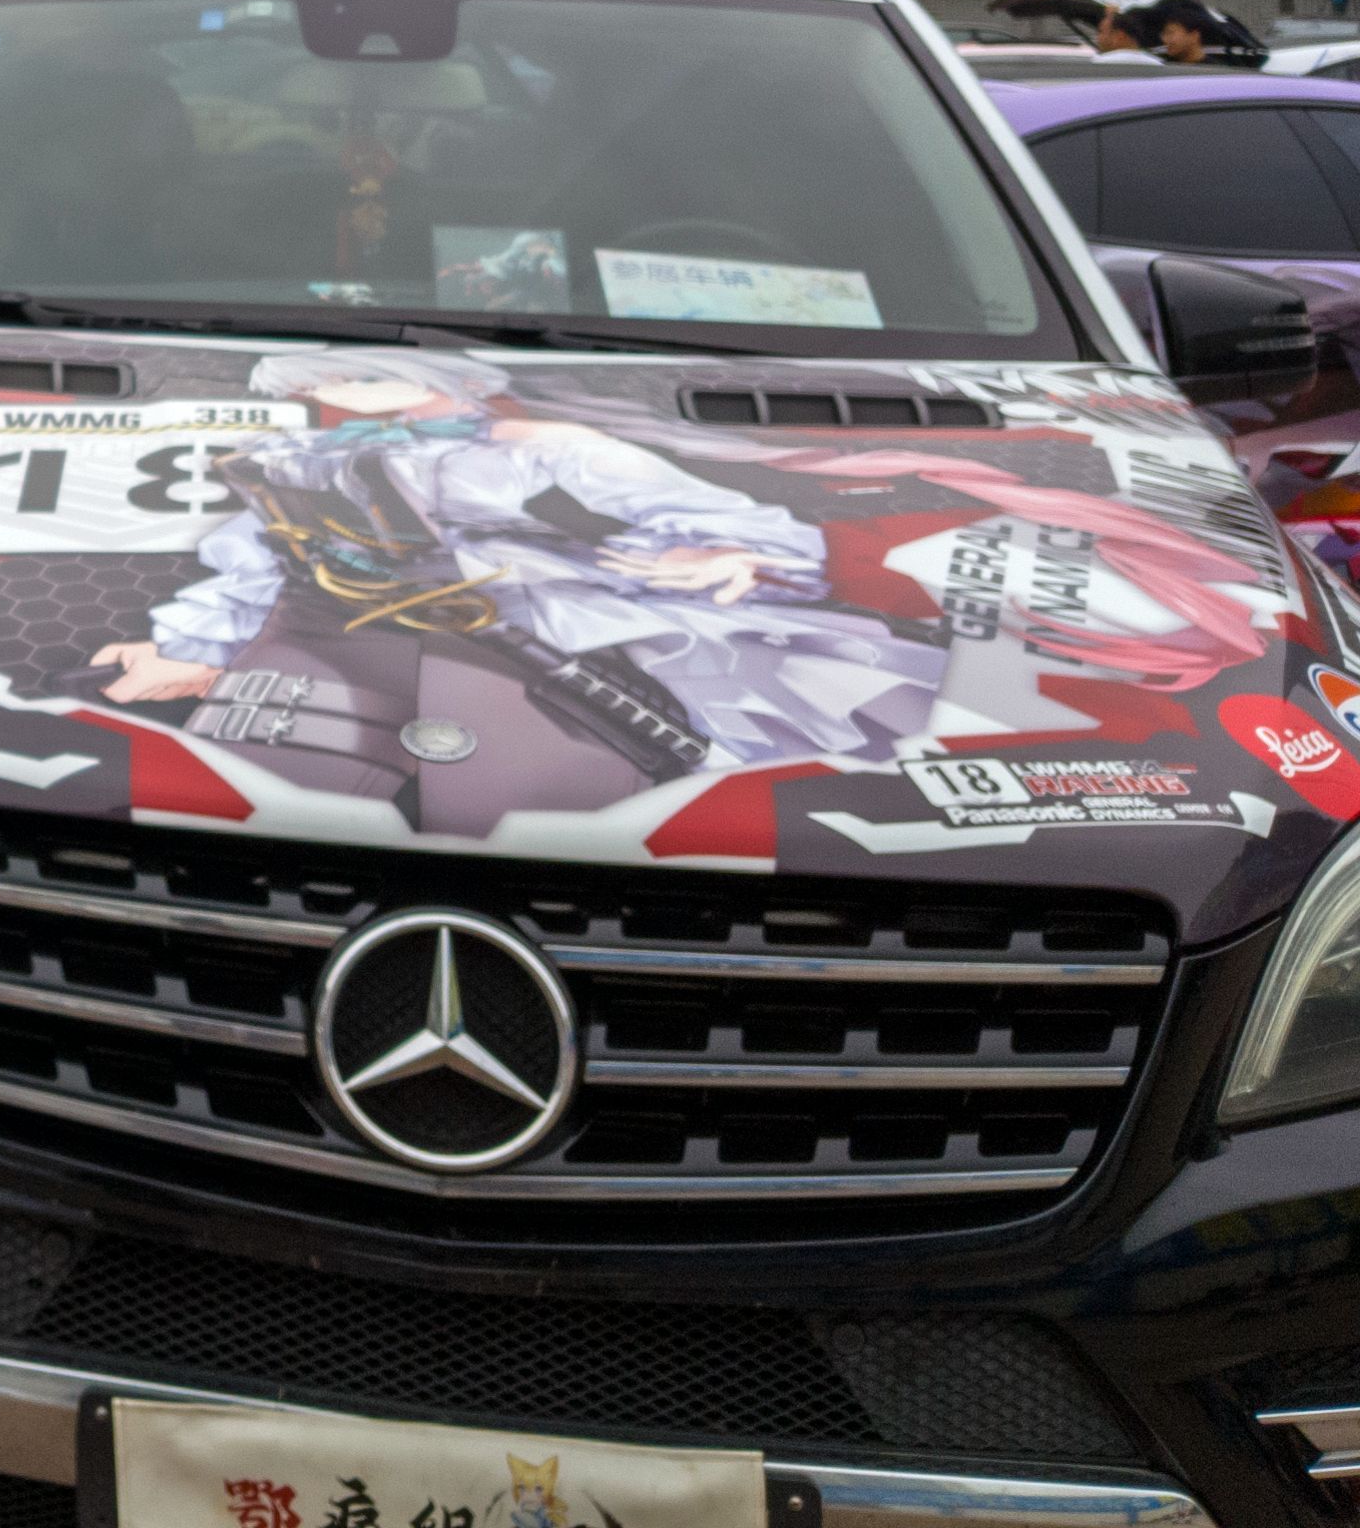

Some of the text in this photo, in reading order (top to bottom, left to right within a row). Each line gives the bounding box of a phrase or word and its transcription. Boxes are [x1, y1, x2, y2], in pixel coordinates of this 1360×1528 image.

[942, 524, 1013, 641] GENERAL
[1255, 726, 1342, 778] Leica
[926, 765, 1002, 796] 18
[1011, 761, 1133, 776] LWMMG
[1022, 775, 1192, 797] RACING
[947, 802, 1087, 826] Panasonic
